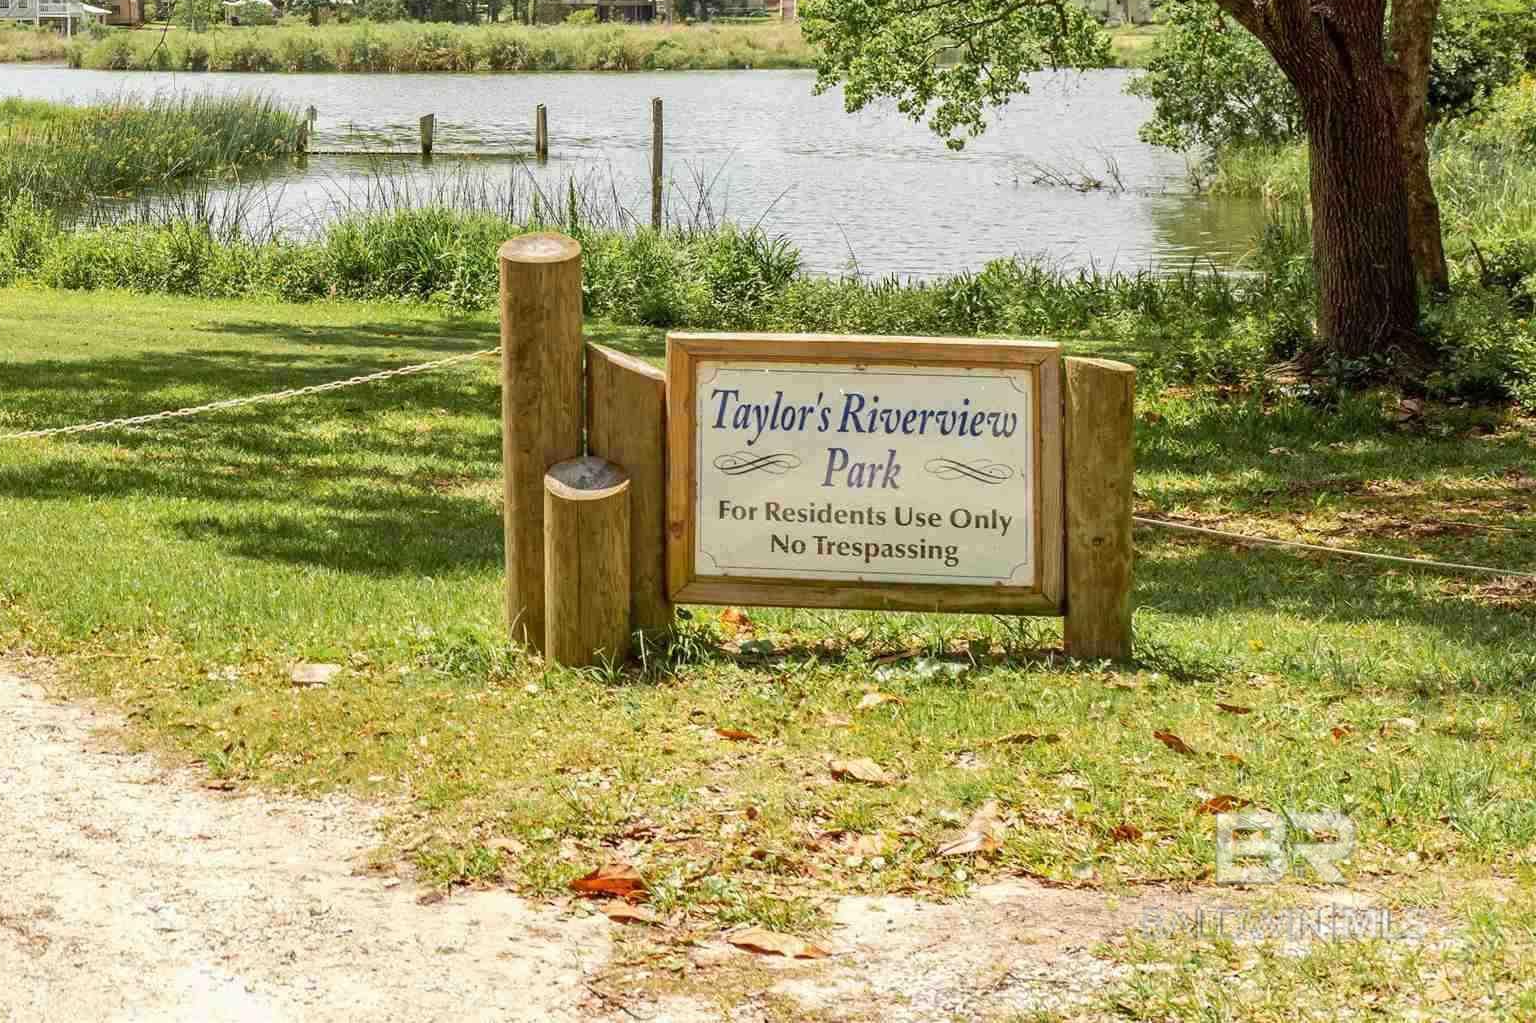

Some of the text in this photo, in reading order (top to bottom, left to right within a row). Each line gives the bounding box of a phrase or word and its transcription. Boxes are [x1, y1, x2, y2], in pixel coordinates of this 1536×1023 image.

[711, 389, 1017, 446] Taylor's Riverview
[821, 447, 902, 490] Park
[719, 500, 1013, 536] For Residents Use Only
[771, 534, 959, 567] No Trespassing
